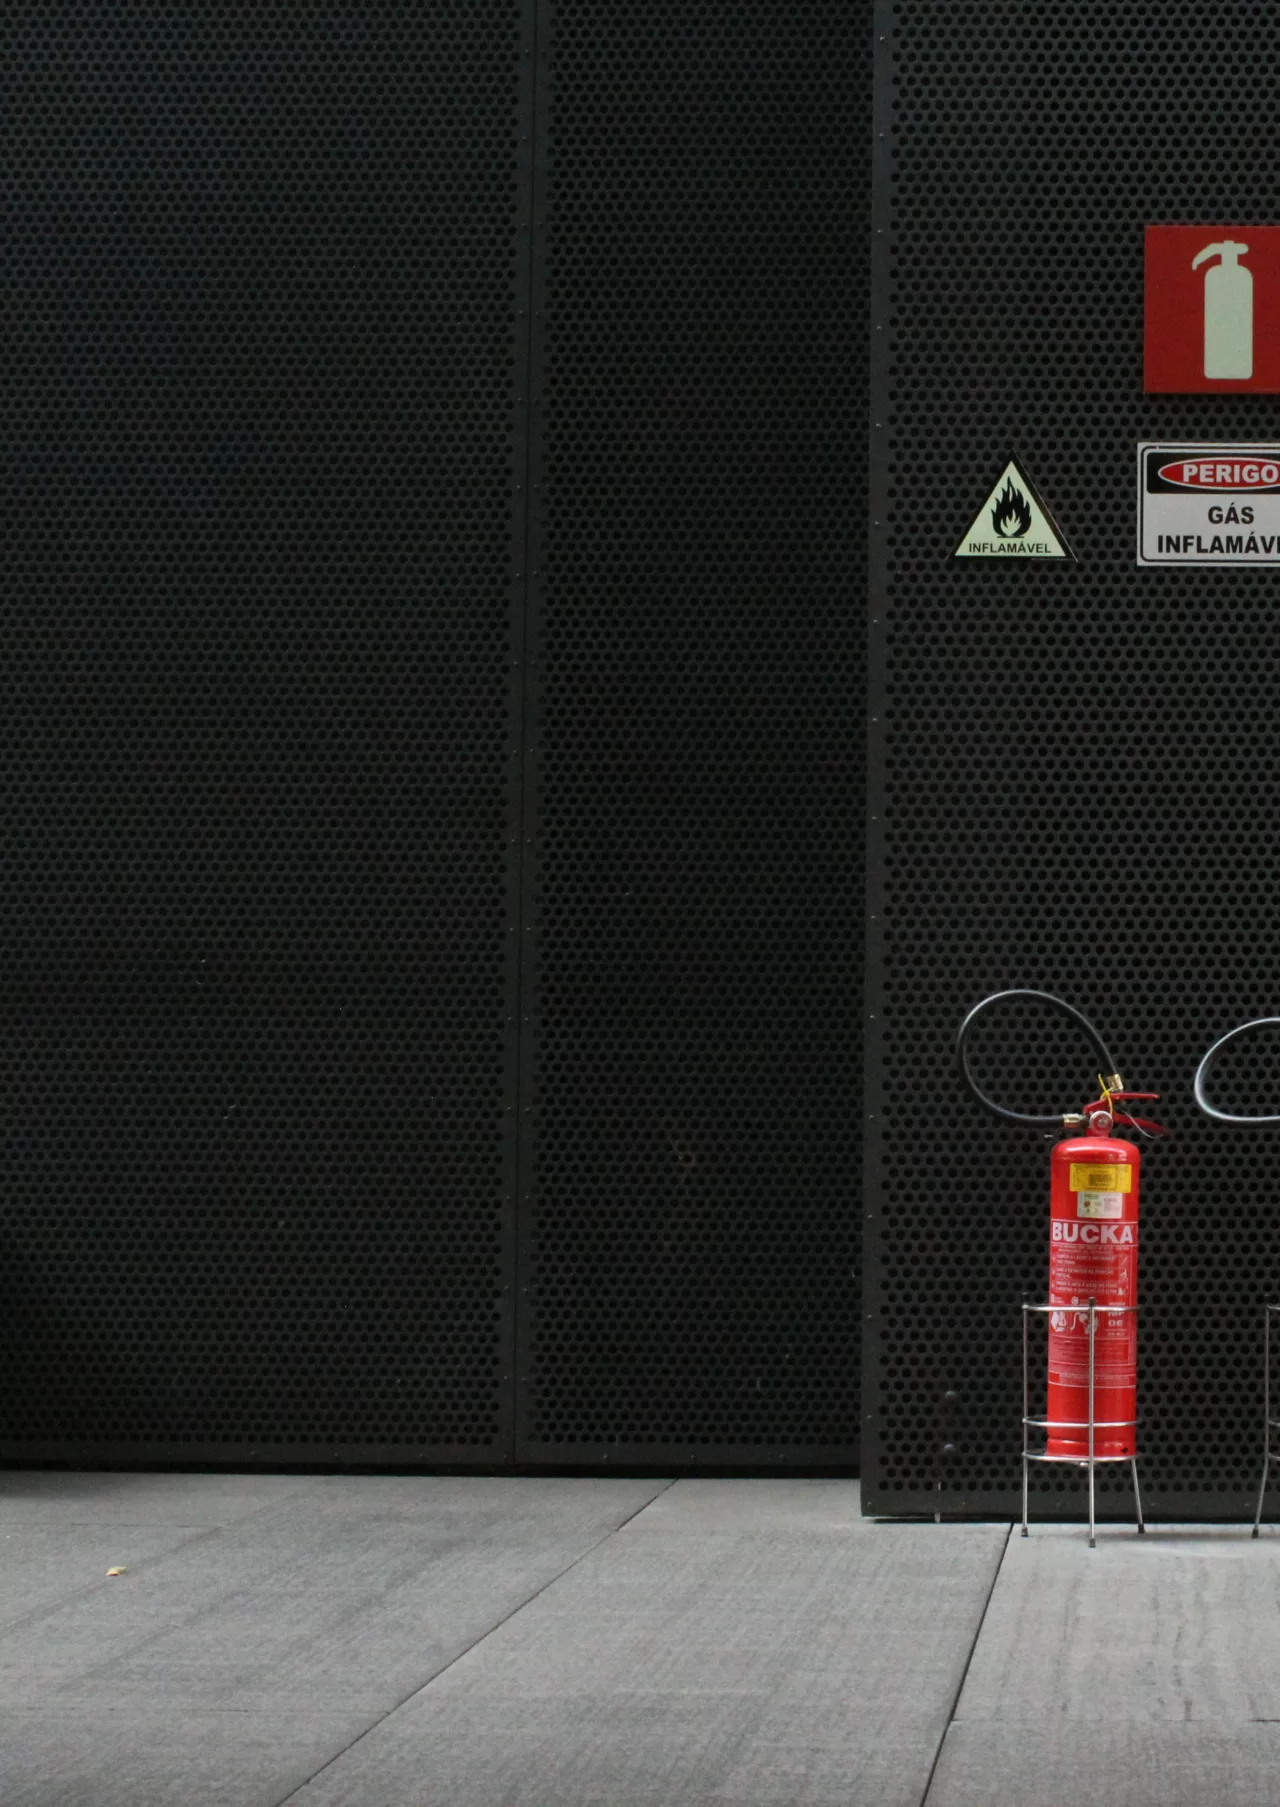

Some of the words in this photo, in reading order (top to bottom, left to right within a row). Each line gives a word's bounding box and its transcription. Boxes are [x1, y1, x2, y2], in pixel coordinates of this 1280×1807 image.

[1183, 463, 1279, 483] PERIGO
[1208, 502, 1254, 525] GÁS
[969, 541, 1052, 553] INFLAMÁVEL
[1052, 1221, 1134, 1244] BUCKA
